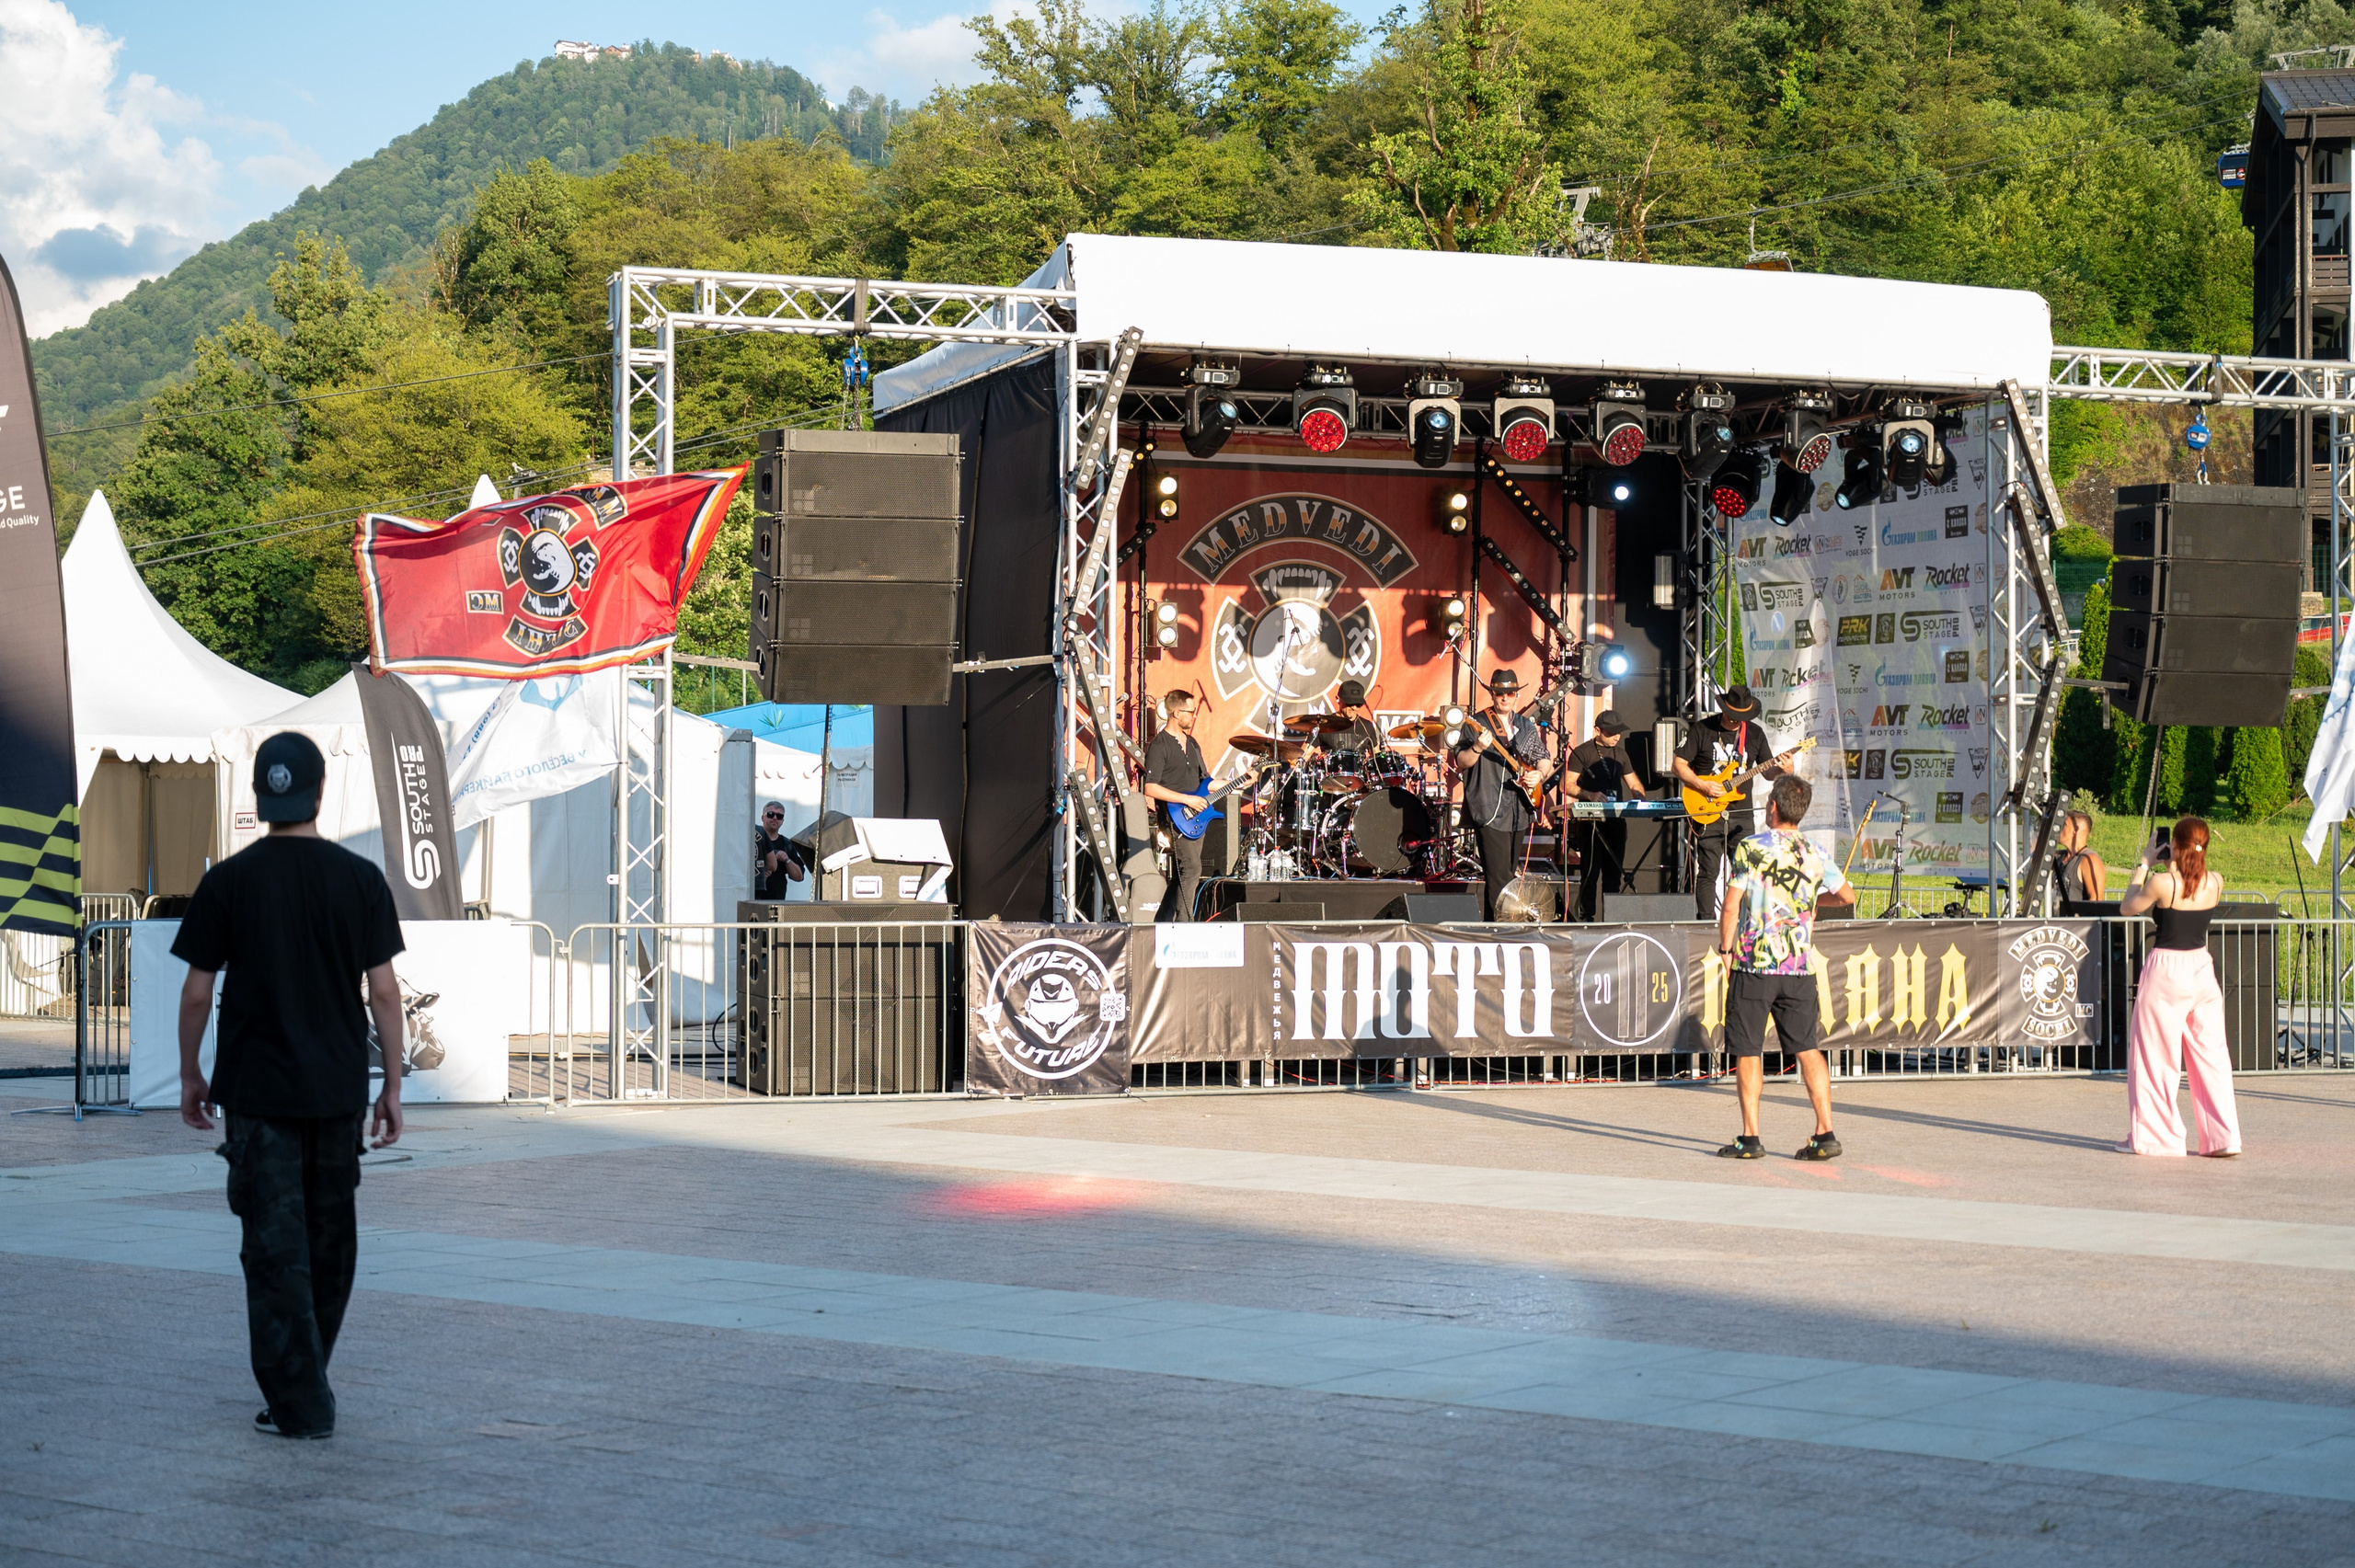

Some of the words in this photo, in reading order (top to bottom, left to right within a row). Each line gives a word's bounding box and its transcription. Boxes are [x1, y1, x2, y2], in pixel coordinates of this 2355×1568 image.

[1923, 486, 1950, 497] STAGE
[6, 514, 40, 530] Quality
[1192, 499, 1403, 575] MEDVEDI
[1738, 536, 1767, 559] AVT
[1775, 533, 1811, 557] Rocket
[1891, 532, 1916, 546] ГАЗПРОМ
[1738, 559, 1766, 567] MOTORS
[1845, 549, 1859, 557] VOGE
[1879, 567, 1915, 591] AVT
[1925, 563, 1970, 588] Rocket
[1775, 589, 1797, 600] SOUTH
[1879, 591, 1915, 601] MOTORS
[1841, 618, 1870, 635] PRK
[1924, 618, 1952, 631] SOUTH
[1924, 630, 1951, 639] STAGE
[1752, 668, 1775, 688] AVT
[1885, 674, 1913, 687] ГАЗПРОМ
[1870, 704, 1911, 727] AVT
[1920, 704, 1970, 728] Rocket
[399, 745, 425, 762] PRO
[1914, 759, 1947, 770] SOUTH
[1914, 770, 1945, 778] STAGE
[1947, 758, 1956, 778] PRO
[402, 763, 424, 835] SOUTH
[417, 764, 433, 833] STAGE
[1874, 811, 1901, 822] ГАЗПРОМ
[1861, 838, 1898, 860] AVT
[1911, 840, 1962, 864] Rocket
[1762, 859, 1811, 894] ART
[2013, 929, 2085, 957] MEDVEDI
[1003, 950, 1104, 1000] RIDERS
[1272, 941, 1281, 1041] МЕДВЕЖЬЯ
[1292, 942, 1557, 1040] МОТО
[1593, 973, 1611, 1004] 20
[1651, 971, 1669, 1003] 25
[2027, 1019, 2073, 1037] SOCHI
[1001, 1023, 1104, 1069] FUTURE
